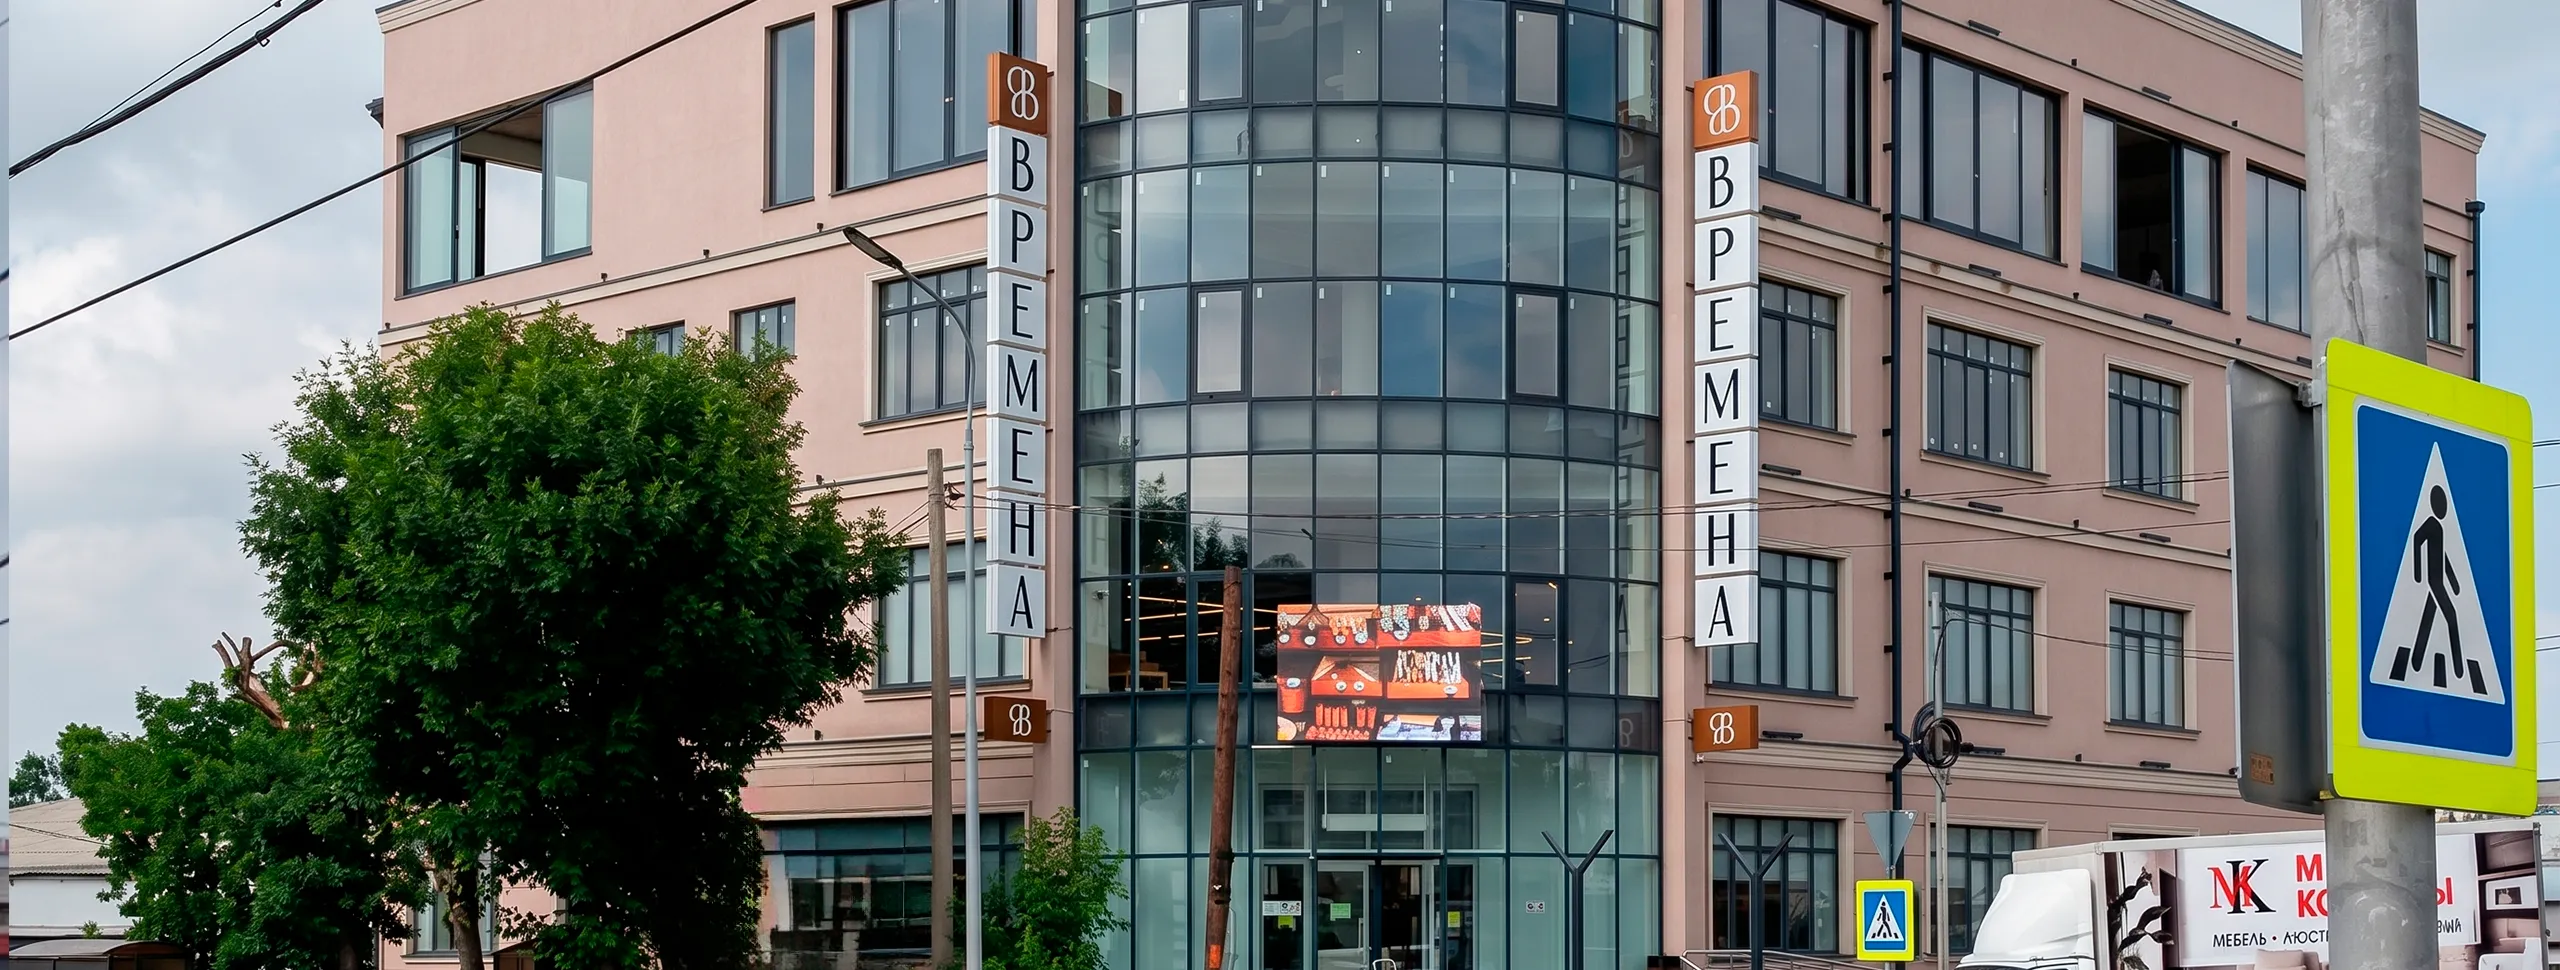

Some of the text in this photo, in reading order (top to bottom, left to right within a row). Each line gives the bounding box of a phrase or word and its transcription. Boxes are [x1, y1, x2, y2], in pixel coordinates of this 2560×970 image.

[1005, 136, 1038, 630] ВРЕМЕНА
[1704, 155, 1739, 639] ВРЕМЕНА
[2212, 932, 2267, 948] МЕБЕЛЬ
[2283, 929, 2329, 945] ЛЮСТ
